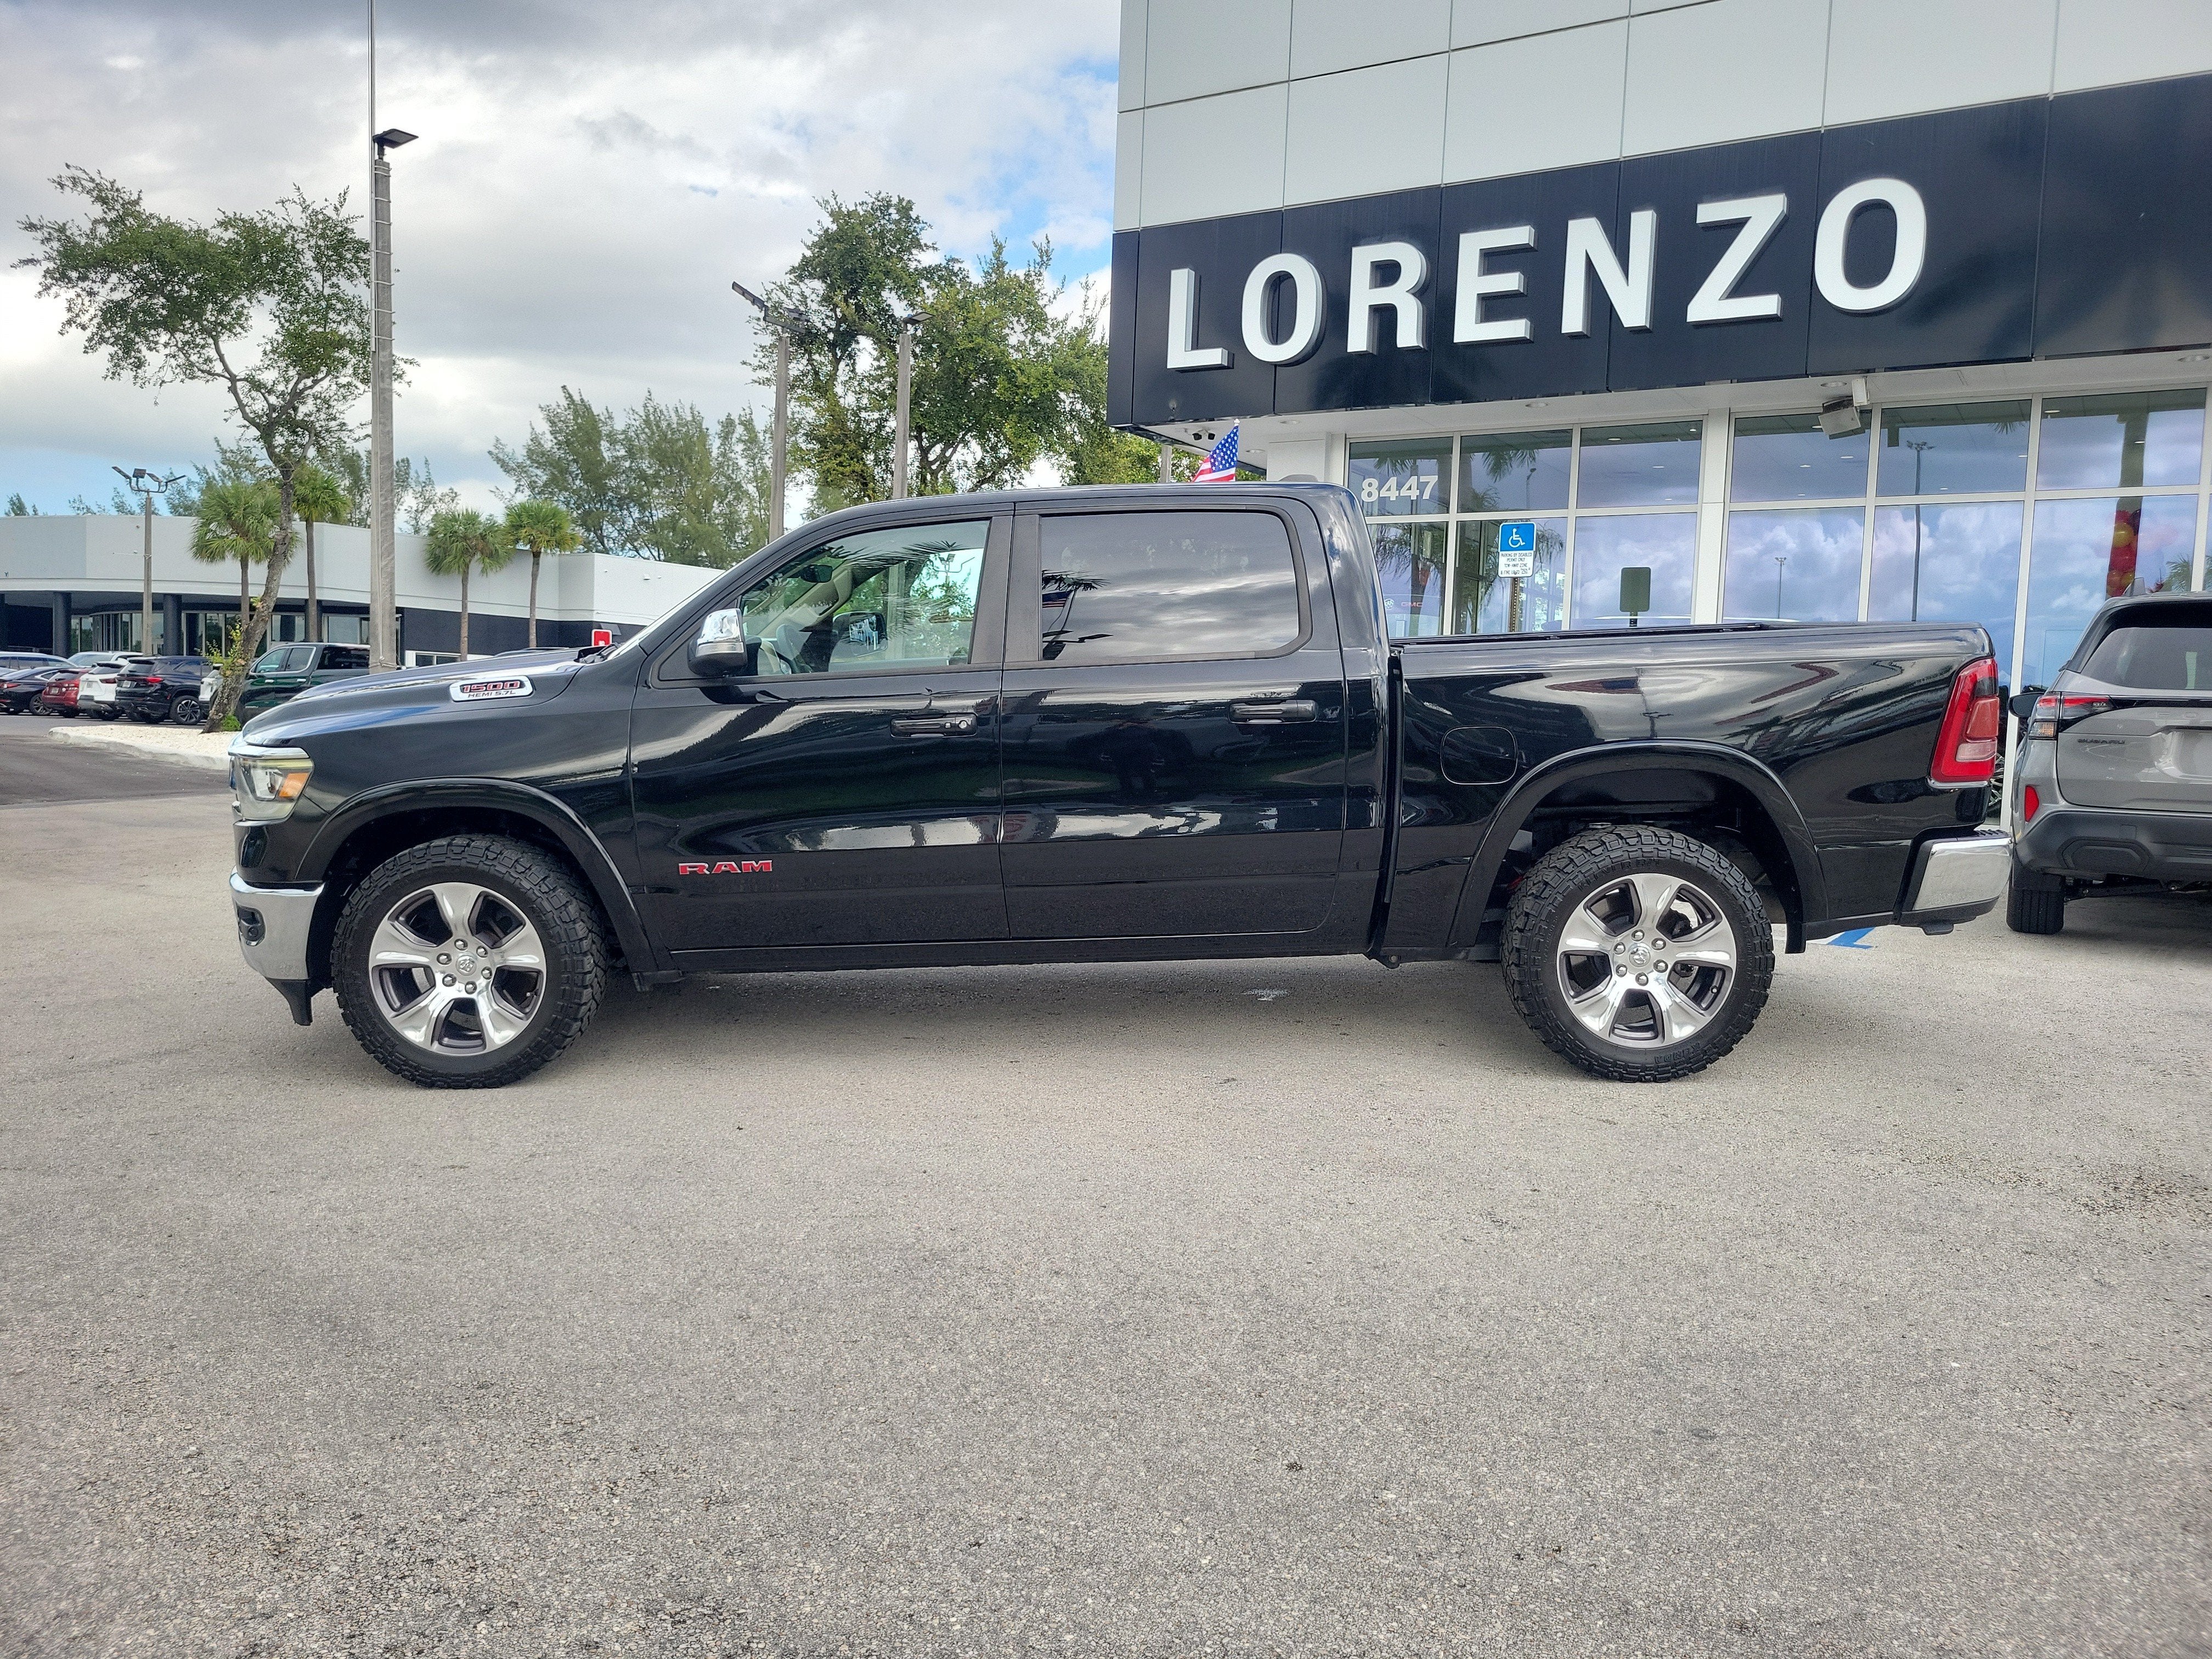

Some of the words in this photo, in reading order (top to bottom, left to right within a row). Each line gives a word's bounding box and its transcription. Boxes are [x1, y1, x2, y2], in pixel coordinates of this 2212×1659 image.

[1167, 178, 1927, 369] LORENZO
[1361, 475, 1438, 503] 8447
[462, 680, 520, 693] 1500
[679, 860, 772, 875] RAM
